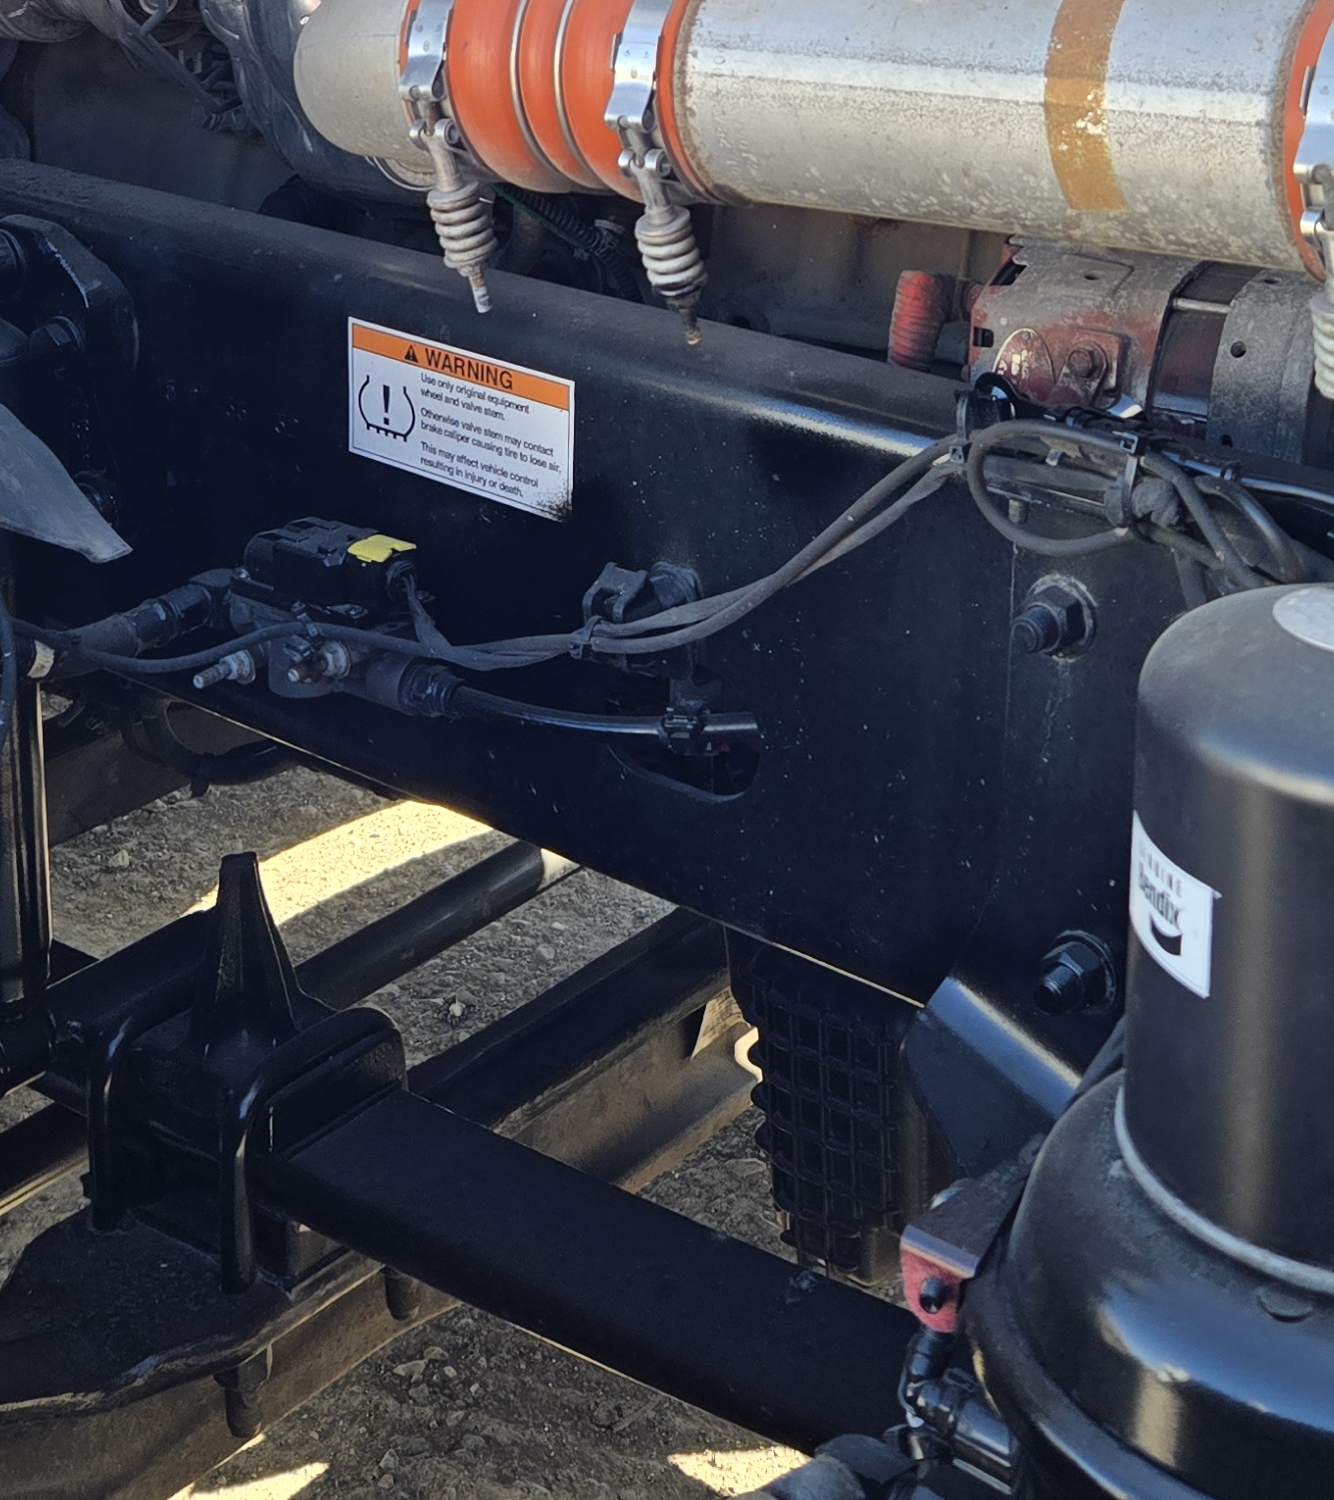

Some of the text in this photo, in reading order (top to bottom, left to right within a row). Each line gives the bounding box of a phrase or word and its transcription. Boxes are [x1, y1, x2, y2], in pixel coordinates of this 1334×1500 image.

[425, 347, 513, 391] WARNING
[420, 388, 506, 421] wheel and valve stem.
[421, 372, 530, 415] Use only original equipment
[420, 420, 563, 474] brake caliper causing tire to lose air.
[421, 407, 555, 458] Otherwise valve stem may contact
[420, 441, 540, 489] This may affect vehicle control
[420, 456, 525, 498] resulting in injury or death.
[1137, 861, 1187, 931] Bendix
